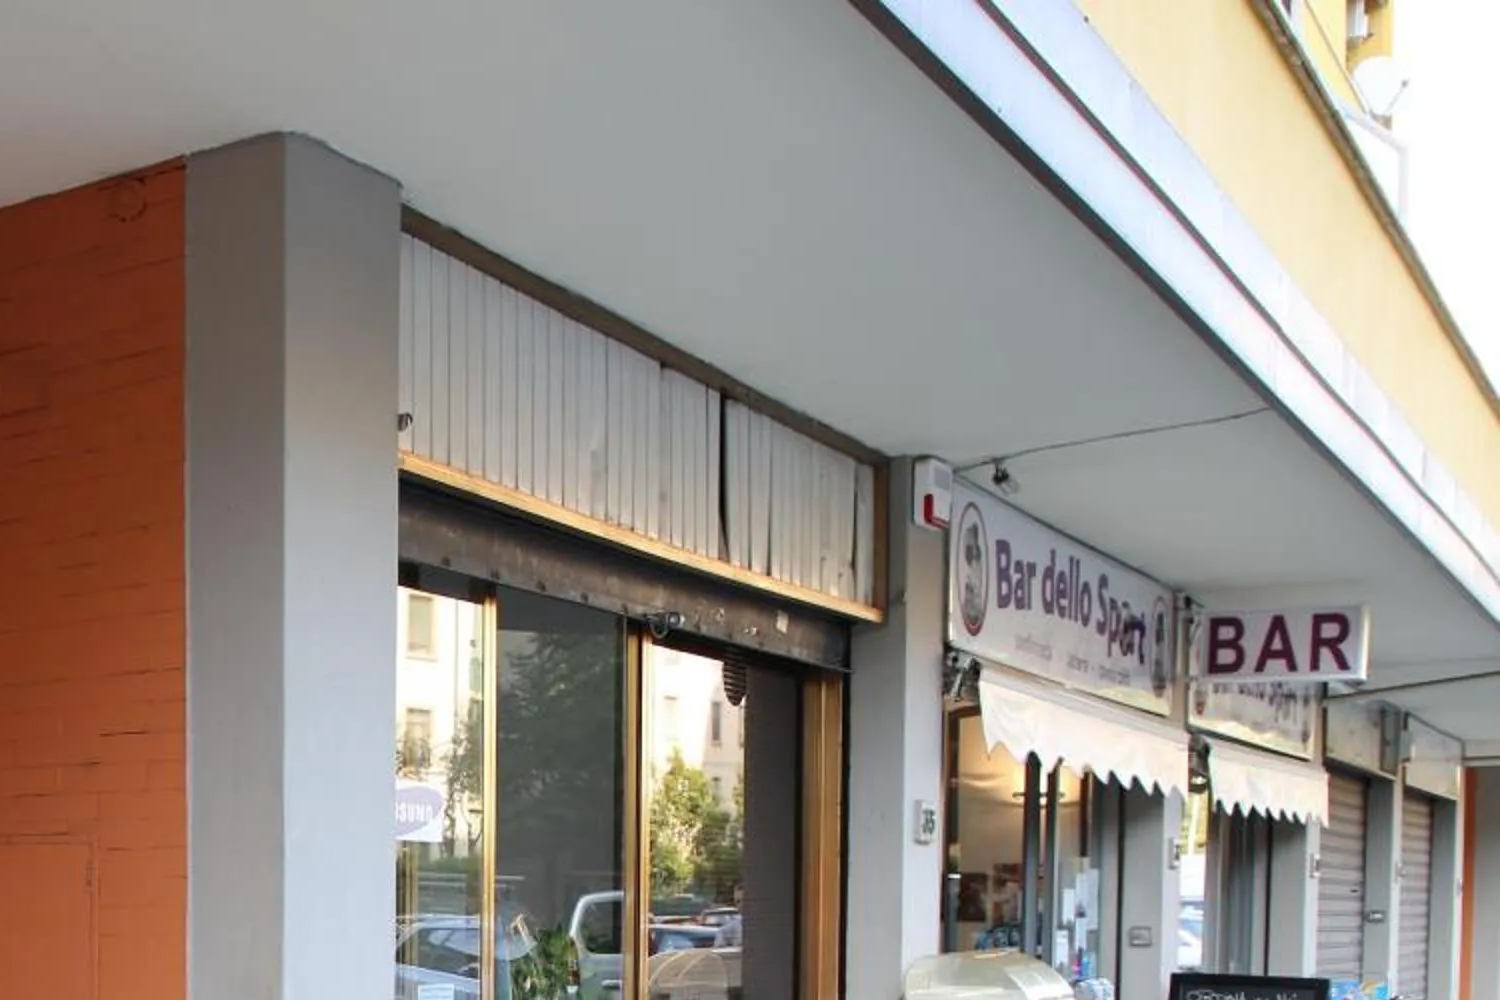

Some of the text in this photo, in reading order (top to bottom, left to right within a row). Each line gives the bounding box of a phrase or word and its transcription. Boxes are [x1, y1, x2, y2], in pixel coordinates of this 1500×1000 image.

[996, 539, 1146, 665] Bar dello Sport
[1207, 613, 1352, 675] BAR
[921, 809, 936, 835] 35
